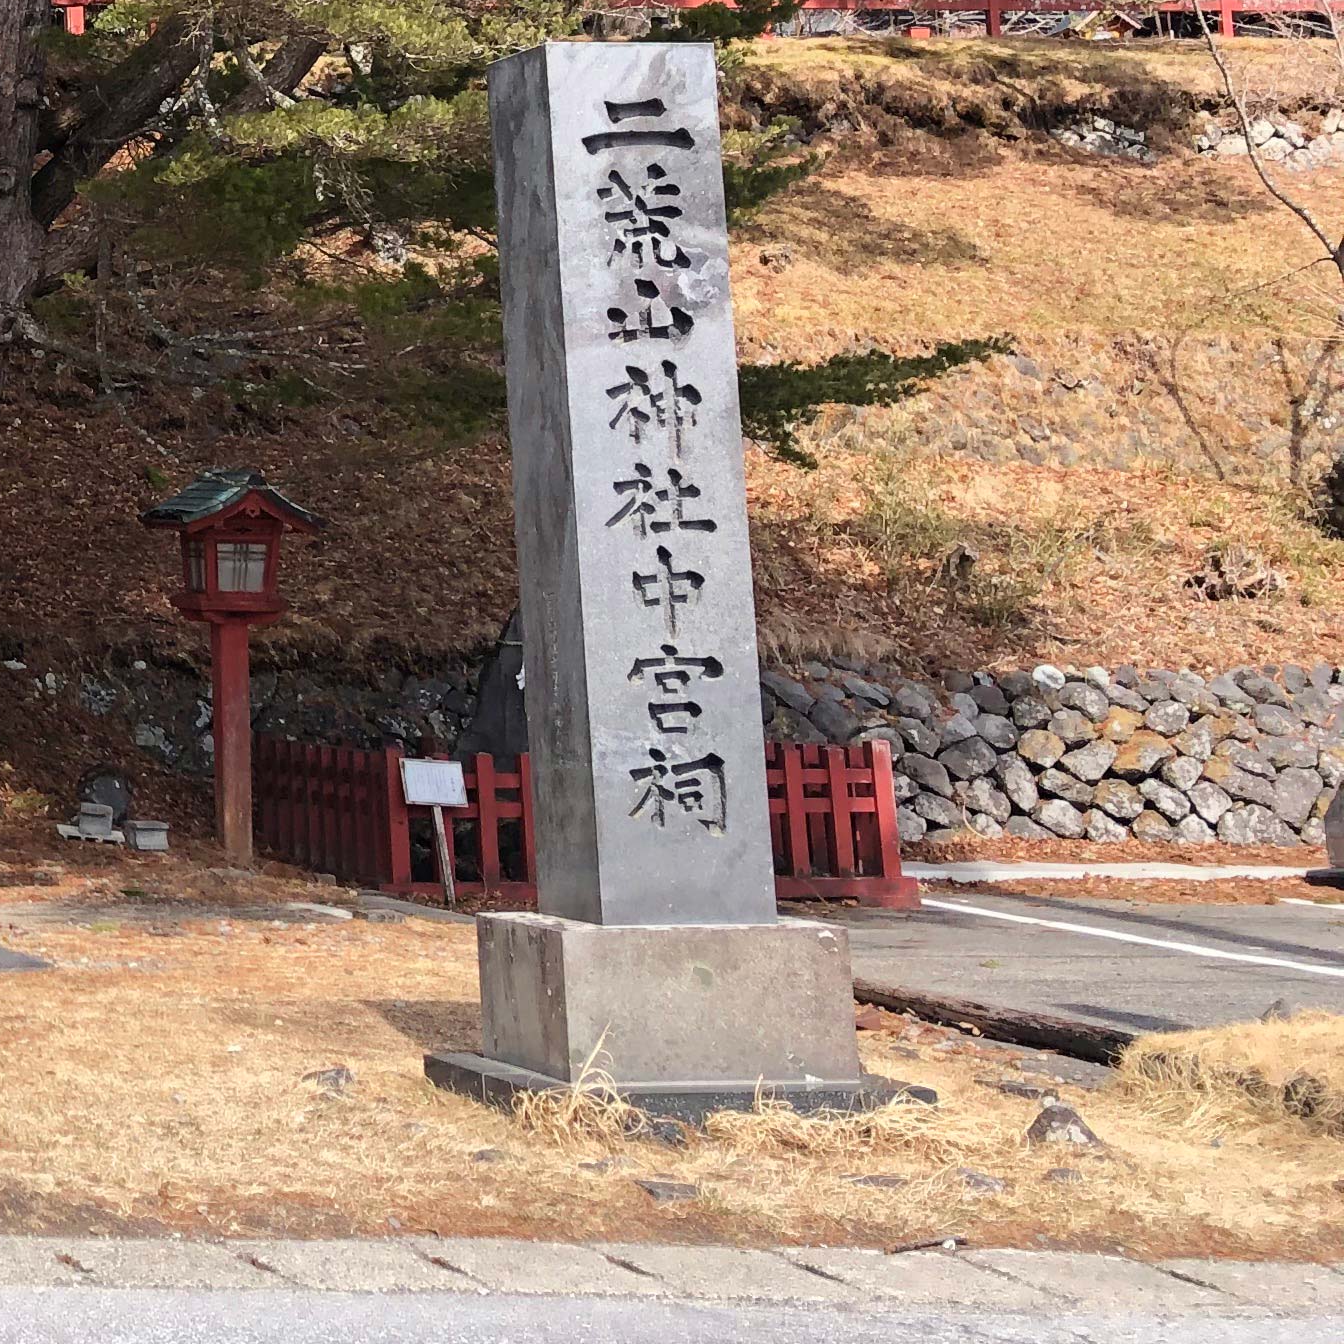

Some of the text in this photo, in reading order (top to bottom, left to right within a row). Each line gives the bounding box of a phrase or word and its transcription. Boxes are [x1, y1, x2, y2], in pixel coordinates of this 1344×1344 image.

[581, 98, 727, 839] 二荒山神社中宮祠
